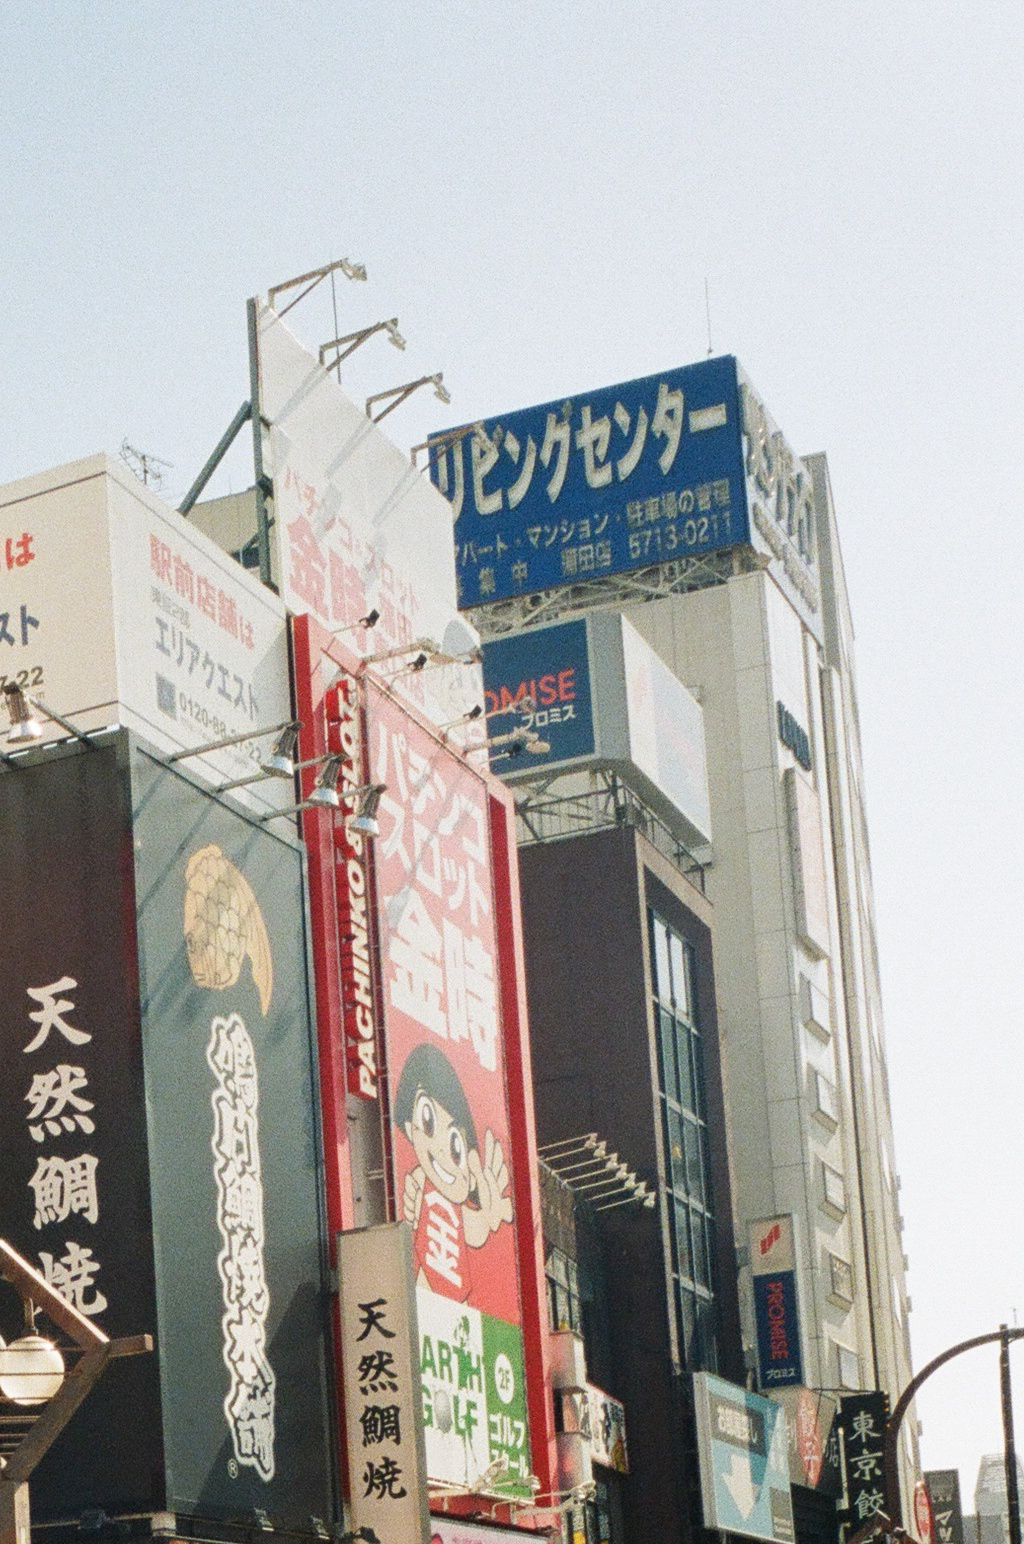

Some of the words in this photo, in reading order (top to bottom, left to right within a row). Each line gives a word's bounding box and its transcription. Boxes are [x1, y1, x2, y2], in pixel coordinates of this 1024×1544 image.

[628, 511, 731, 559] 5713-0211
[155, 616, 259, 722] エリアクエスト
[484, 669, 577, 715] OMISE
[521, 704, 577, 729] プロミス
[376, 721, 488, 868] パチンコ
[379, 794, 490, 931] スロット
[347, 857, 378, 1099] PACHINKO
[23, 976, 108, 1317] 天然鯛焼
[421, 1334, 483, 1394] ARTH
[766, 1281, 790, 1360] PROMISE
[355, 1298, 407, 1500] 天然鯛焼
[497, 1366, 511, 1389] 2F
